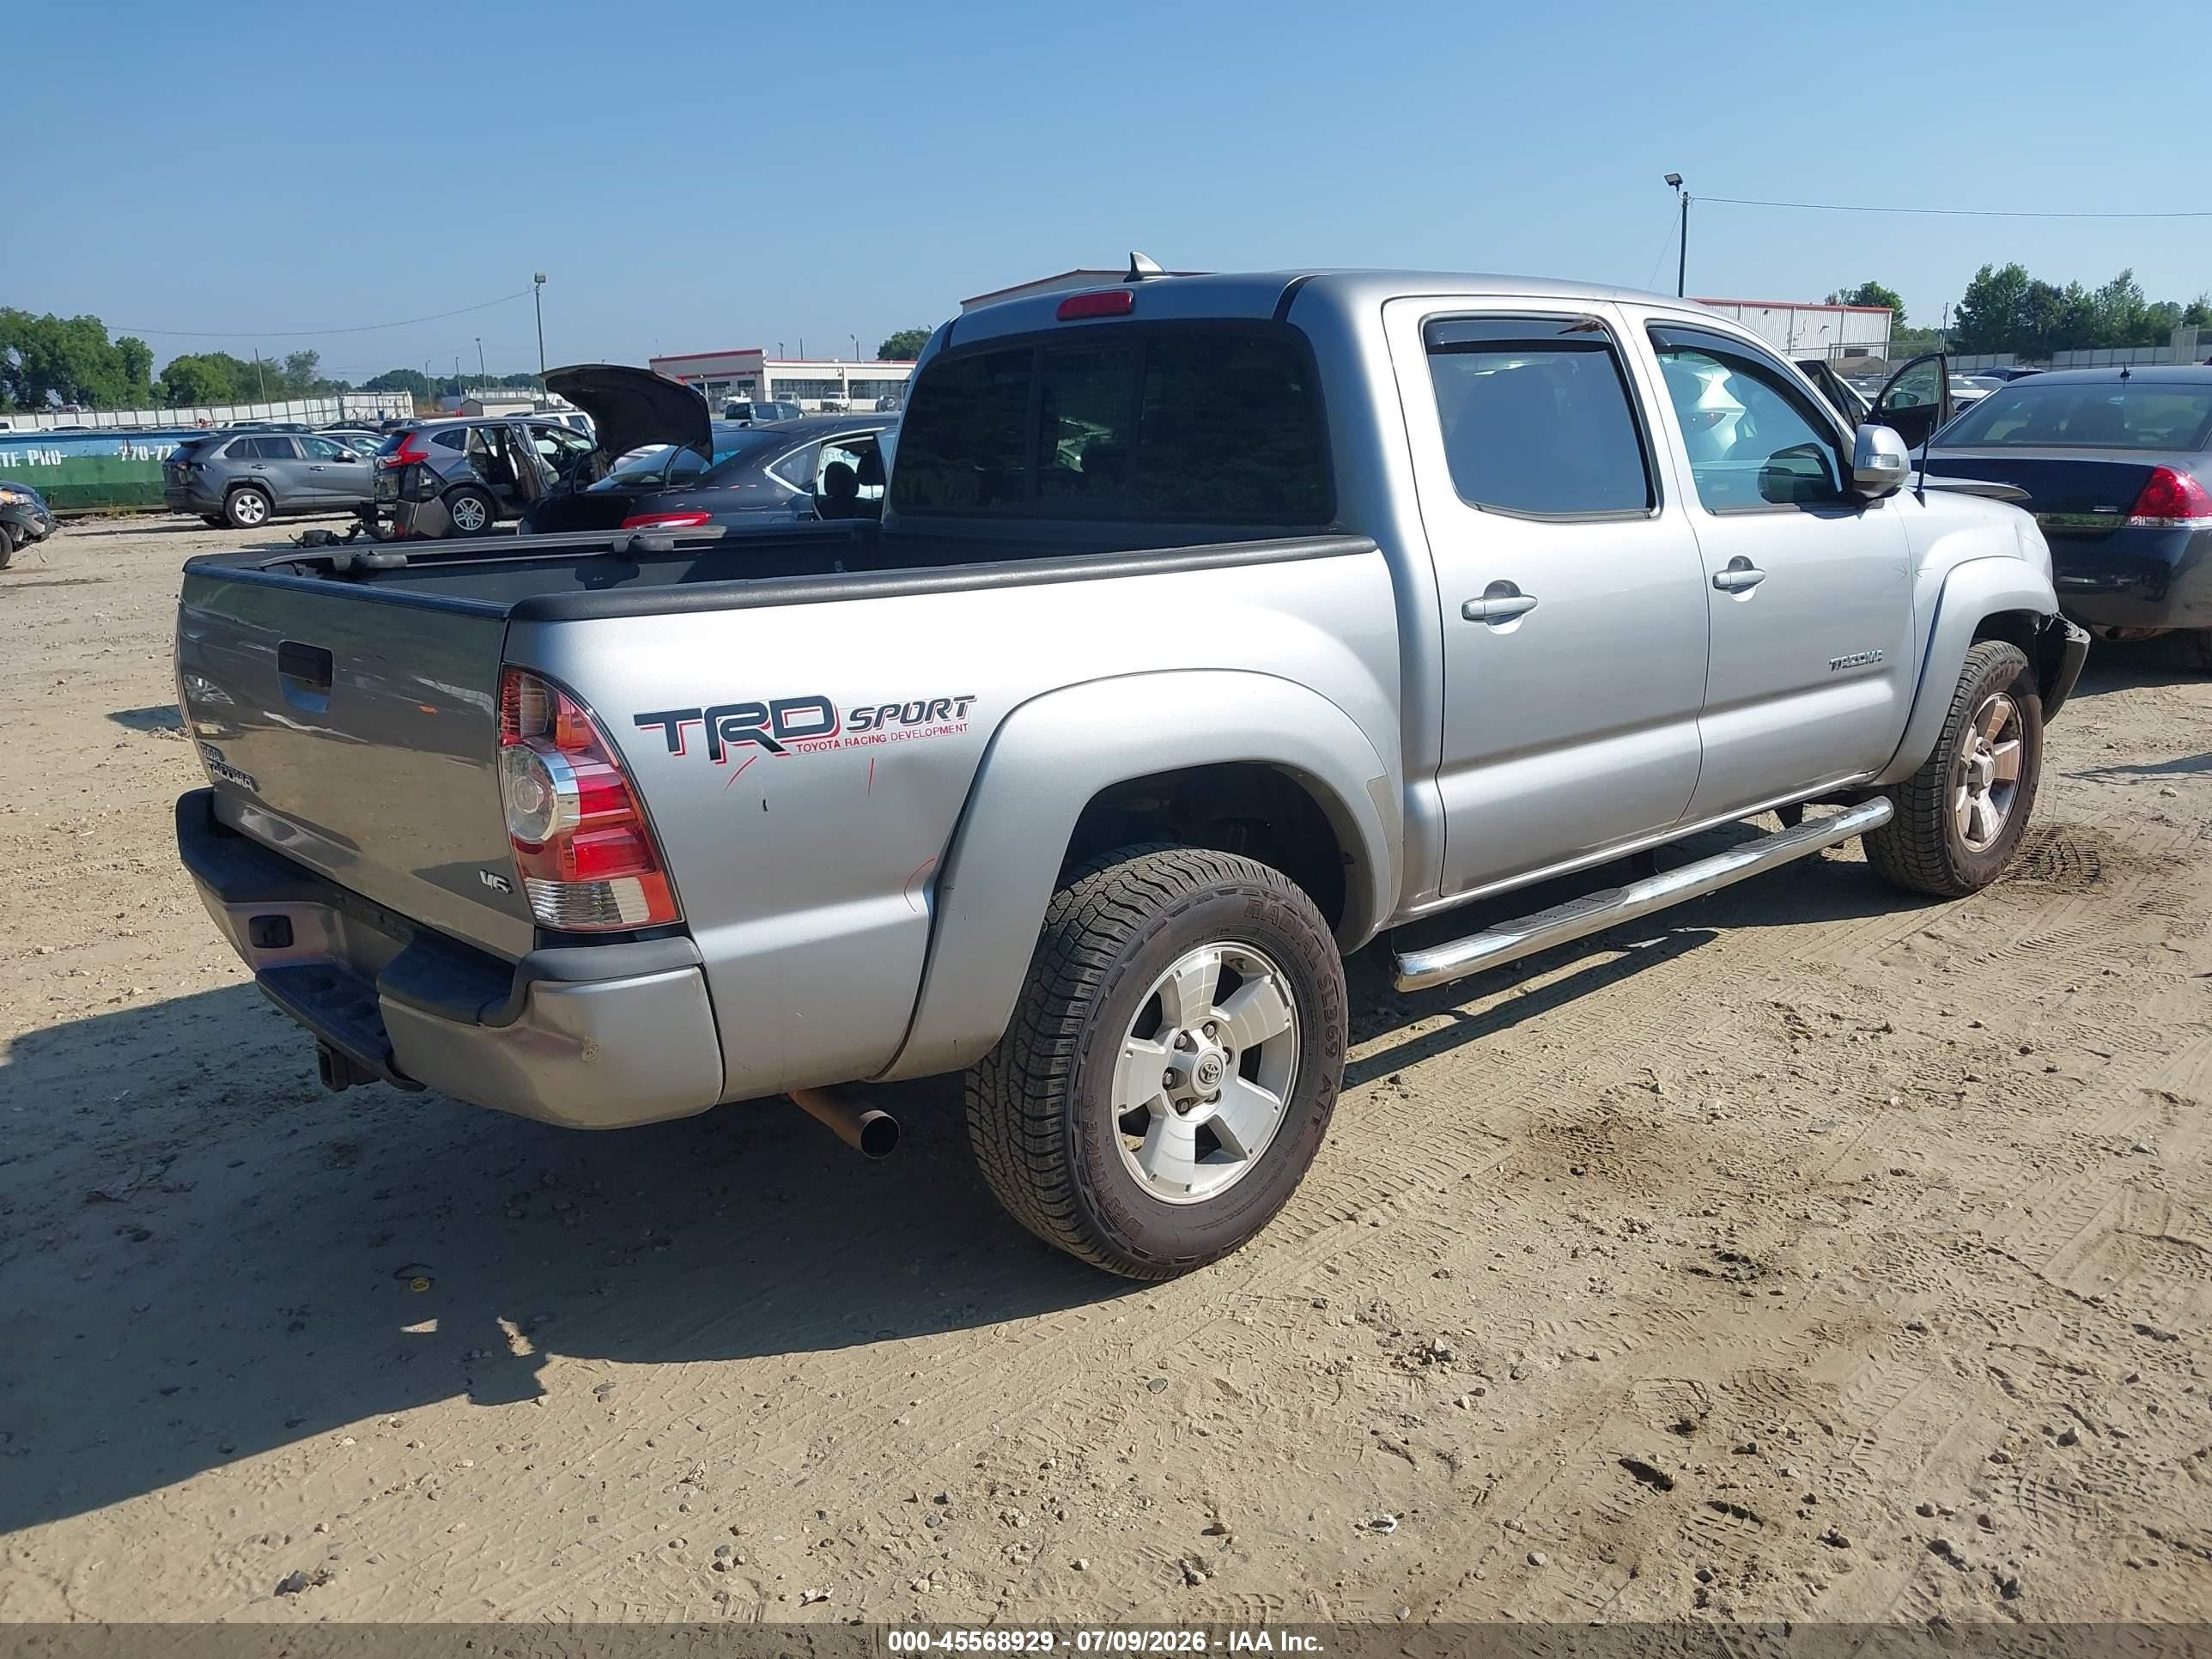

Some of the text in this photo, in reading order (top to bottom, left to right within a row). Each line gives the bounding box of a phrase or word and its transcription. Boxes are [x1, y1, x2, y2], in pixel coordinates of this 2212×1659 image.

[634, 694, 979, 765] TRD SPORT
[796, 722, 969, 754] TOYOTA RACING DEVELOPMENT
[479, 869, 513, 894] V6
